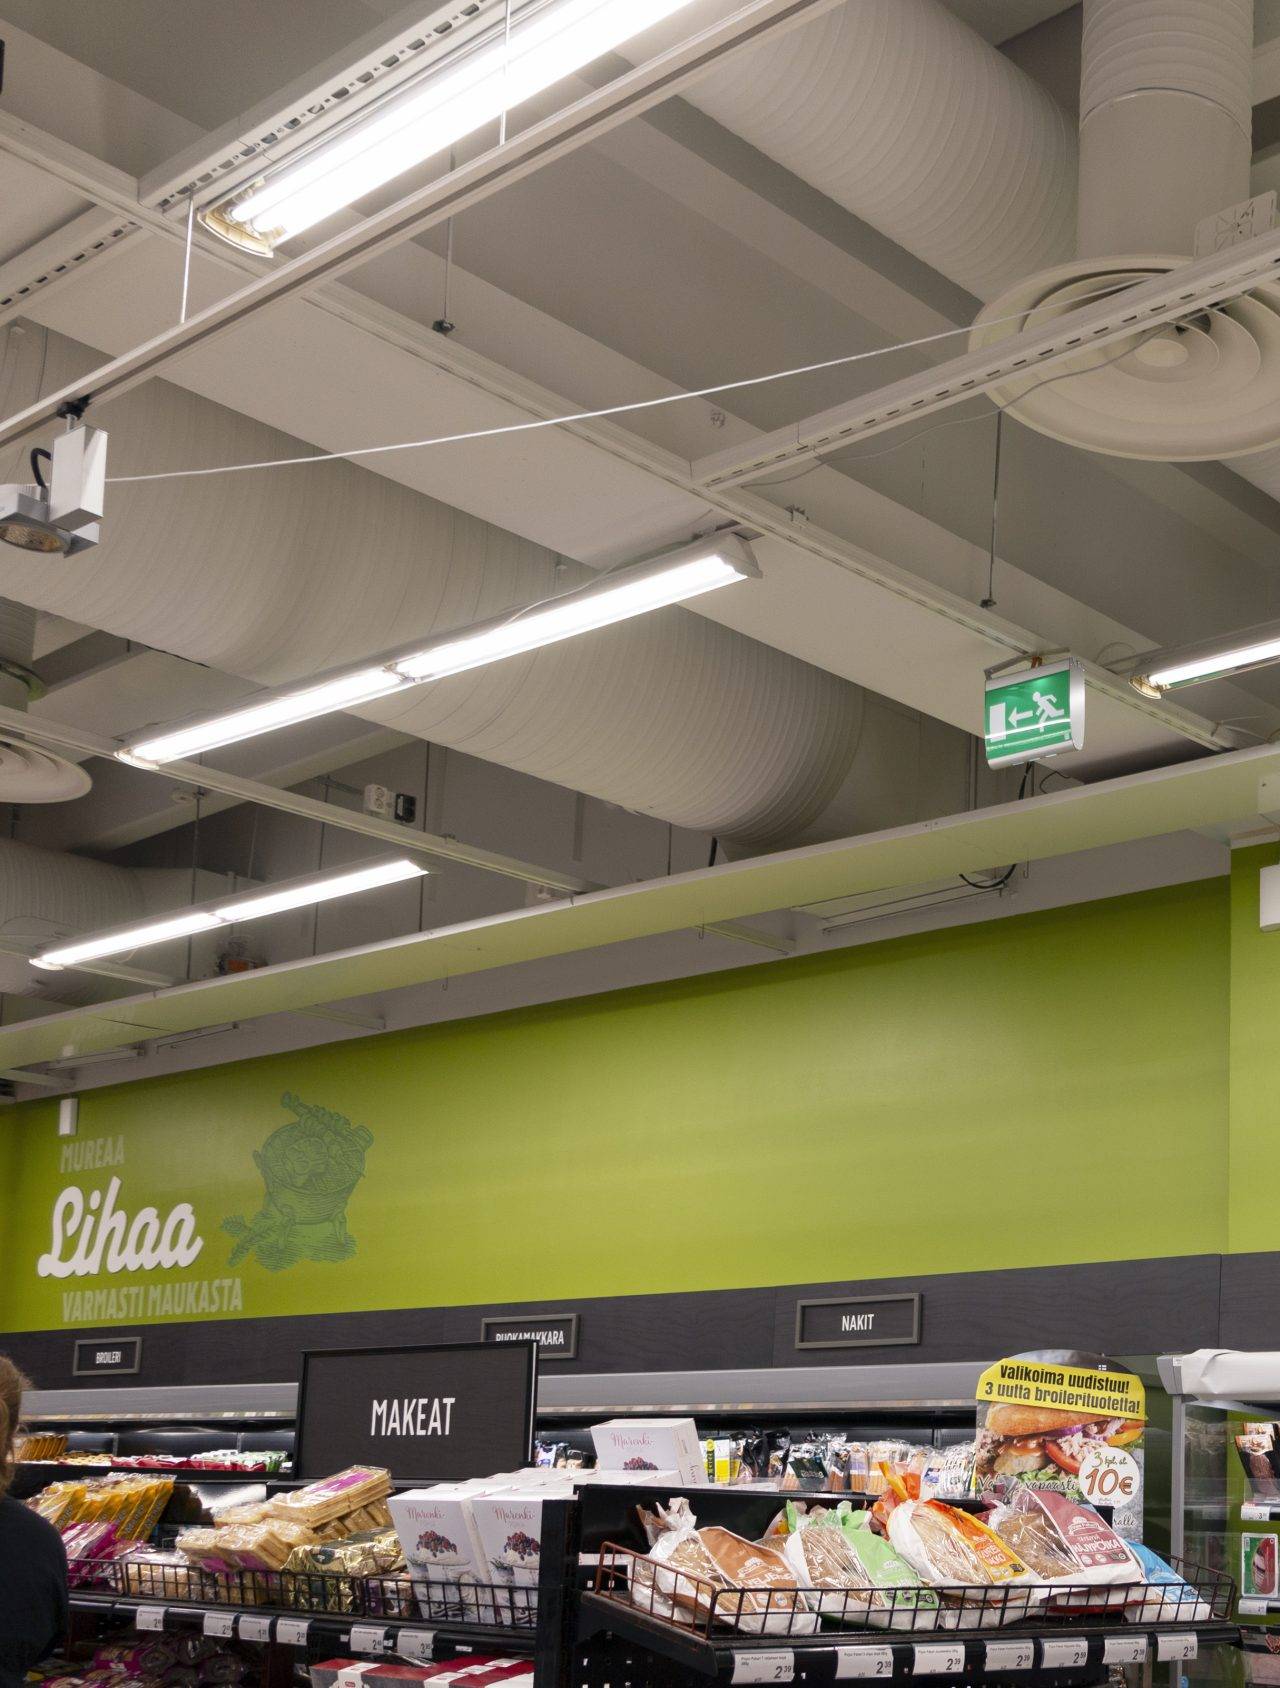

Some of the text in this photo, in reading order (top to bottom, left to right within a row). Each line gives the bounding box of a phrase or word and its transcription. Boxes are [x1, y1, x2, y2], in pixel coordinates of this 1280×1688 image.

[60, 1135, 125, 1174] MUREAA
[37, 1176, 204, 1278] Lihaa
[62, 1278, 243, 1323] VARMASTI MAUKASTA
[841, 1314, 874, 1331] NAKIT
[96, 1351, 122, 1364] BROILERI
[1000, 1364, 1130, 1394] Valikoima uudistuu!
[985, 1382, 1140, 1413] 3 uutta broilerituotetta!
[371, 1398, 455, 1436] MAKEAT
[1092, 1452, 1103, 1468] 3
[1086, 1469, 1133, 1496] 10€
